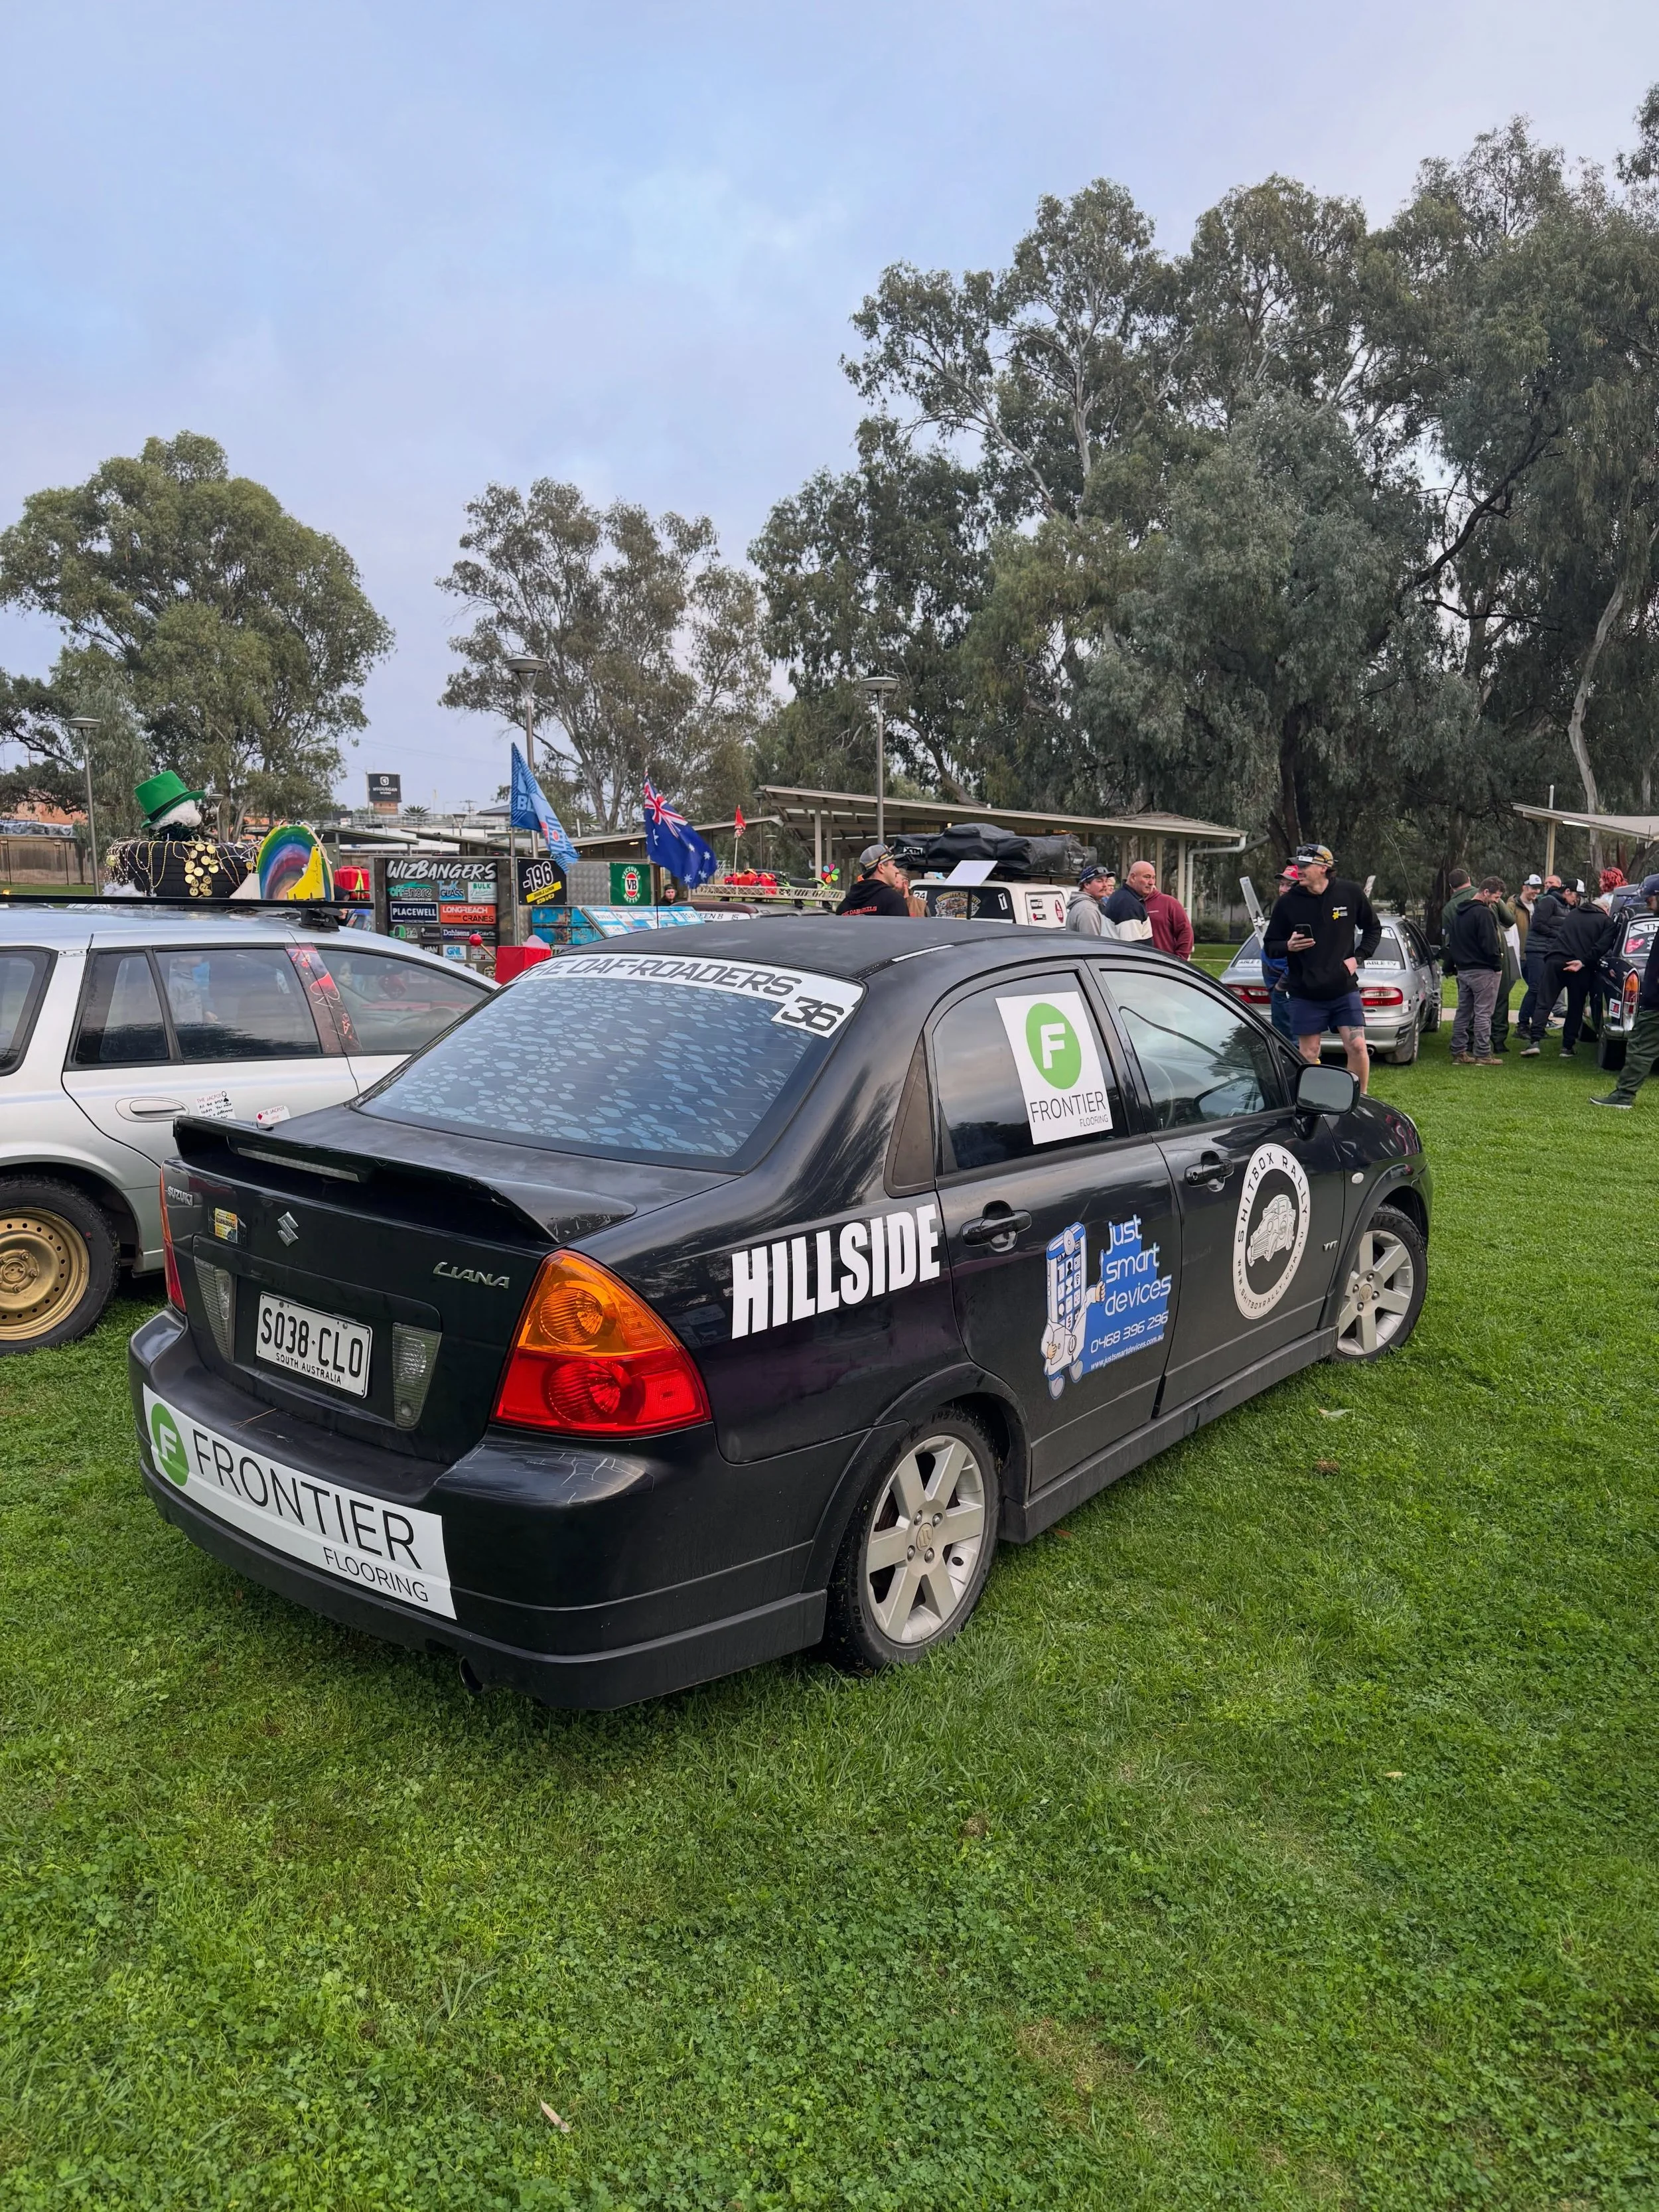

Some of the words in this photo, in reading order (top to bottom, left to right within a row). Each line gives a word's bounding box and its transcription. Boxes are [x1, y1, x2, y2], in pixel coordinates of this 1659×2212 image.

[386, 859, 496, 880] WIZBANGERS
[523, 861, 553, 892] -196
[626, 880, 637, 889] VB
[393, 907, 436, 916] PLACEWELL
[567, 958, 802, 996] OAF-ROADERS
[780, 996, 845, 1032] 36
[1041, 1023, 1065, 1069] F
[1030, 1091, 1106, 1123] FRONTIER
[1079, 1114, 1109, 1127] FLOORING
[168, 1186, 192, 1206] SUZUKI
[1238, 1152, 1274, 1243] SHITBOX
[1282, 1155, 1308, 1214] RALLY
[1106, 1215, 1142, 1254] just
[433, 1262, 510, 1289] LIANA
[731, 1204, 940, 1339] HILLSIDE
[1106, 1242, 1160, 1284] smart
[1104, 1274, 1172, 1317] devices
[1090, 1331, 1120, 1354] 0468
[1123, 1320, 1145, 1341] 396
[1147, 1310, 1169, 1331] 296
[275, 1352, 300, 1368] SOUTH
[301, 1363, 342, 1384] AUSTRALIA
[1090, 1333, 1165, 1370] www.justsmartdevices.com.au
[159, 1423, 177, 1461] F
[192, 1428, 423, 1570] FRONTIER
[323, 1546, 429, 1602] FLOORING
